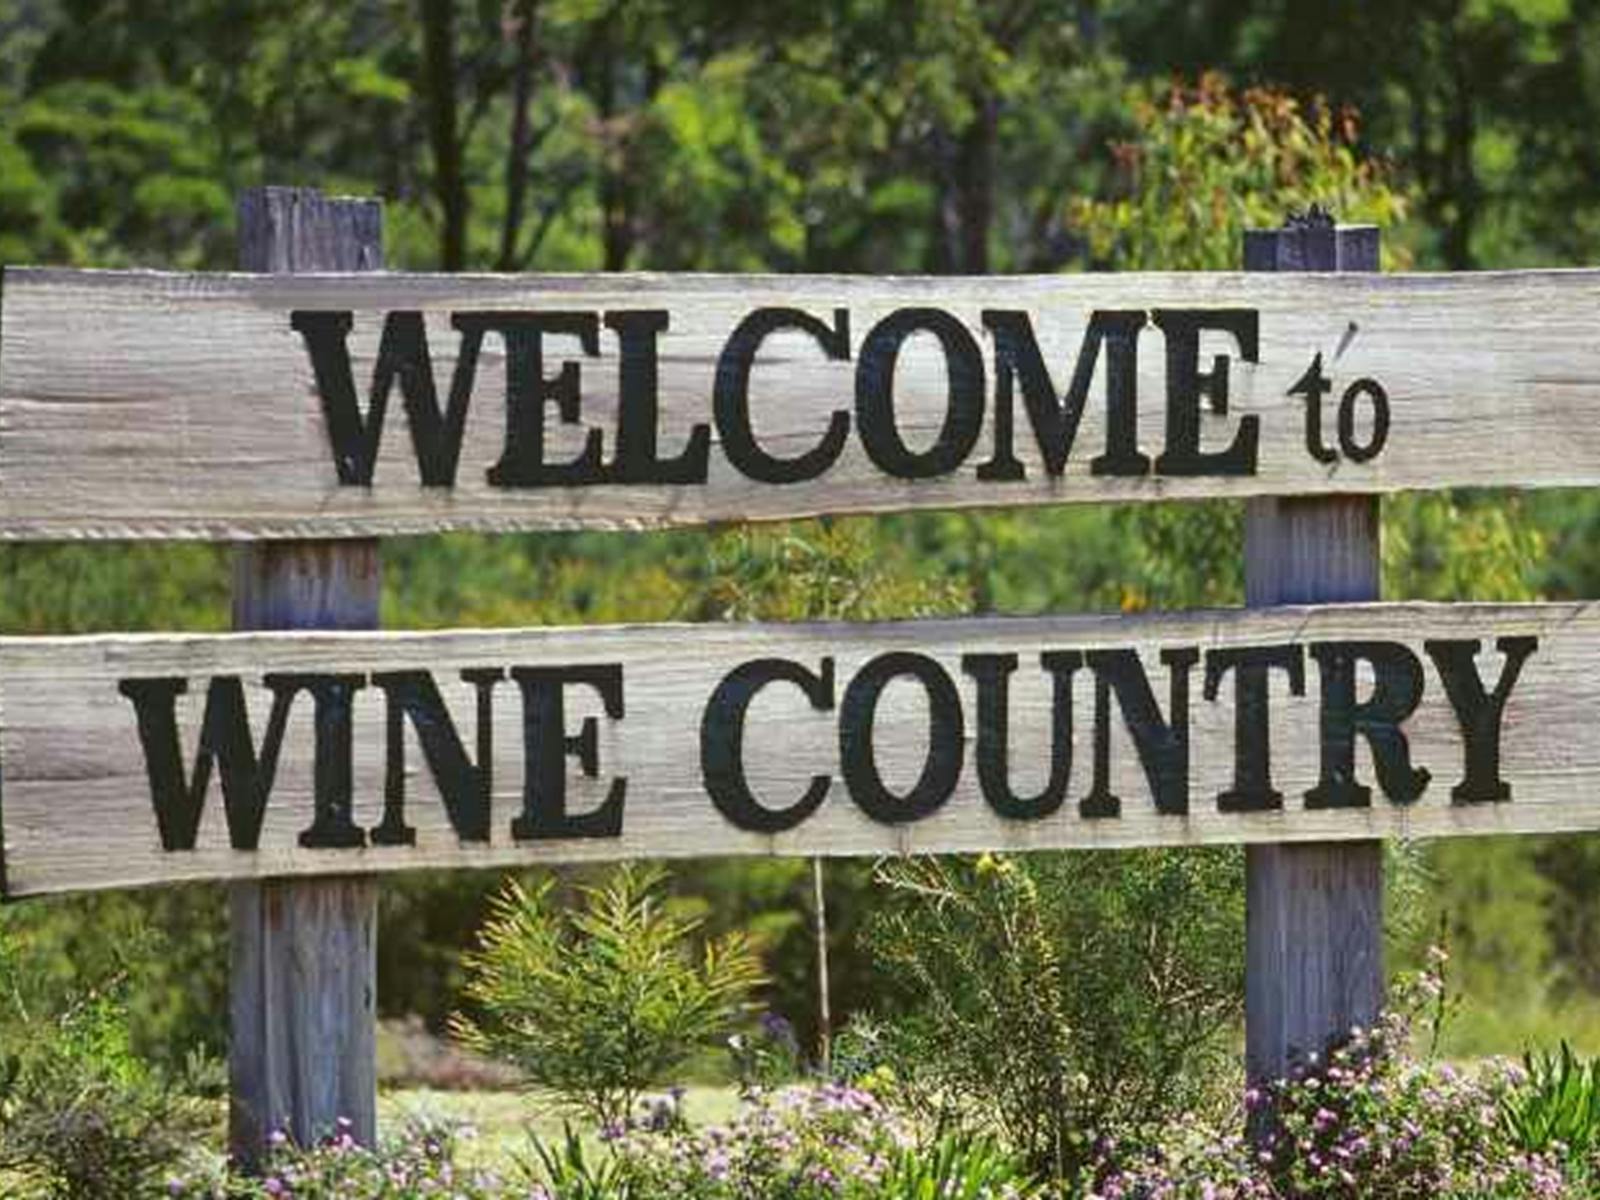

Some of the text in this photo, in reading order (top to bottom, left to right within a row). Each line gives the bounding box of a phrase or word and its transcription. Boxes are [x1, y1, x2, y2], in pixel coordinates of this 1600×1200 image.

[290, 307, 1391, 489] WELCOME to
[118, 635, 1538, 852] WINE COUNTRY
